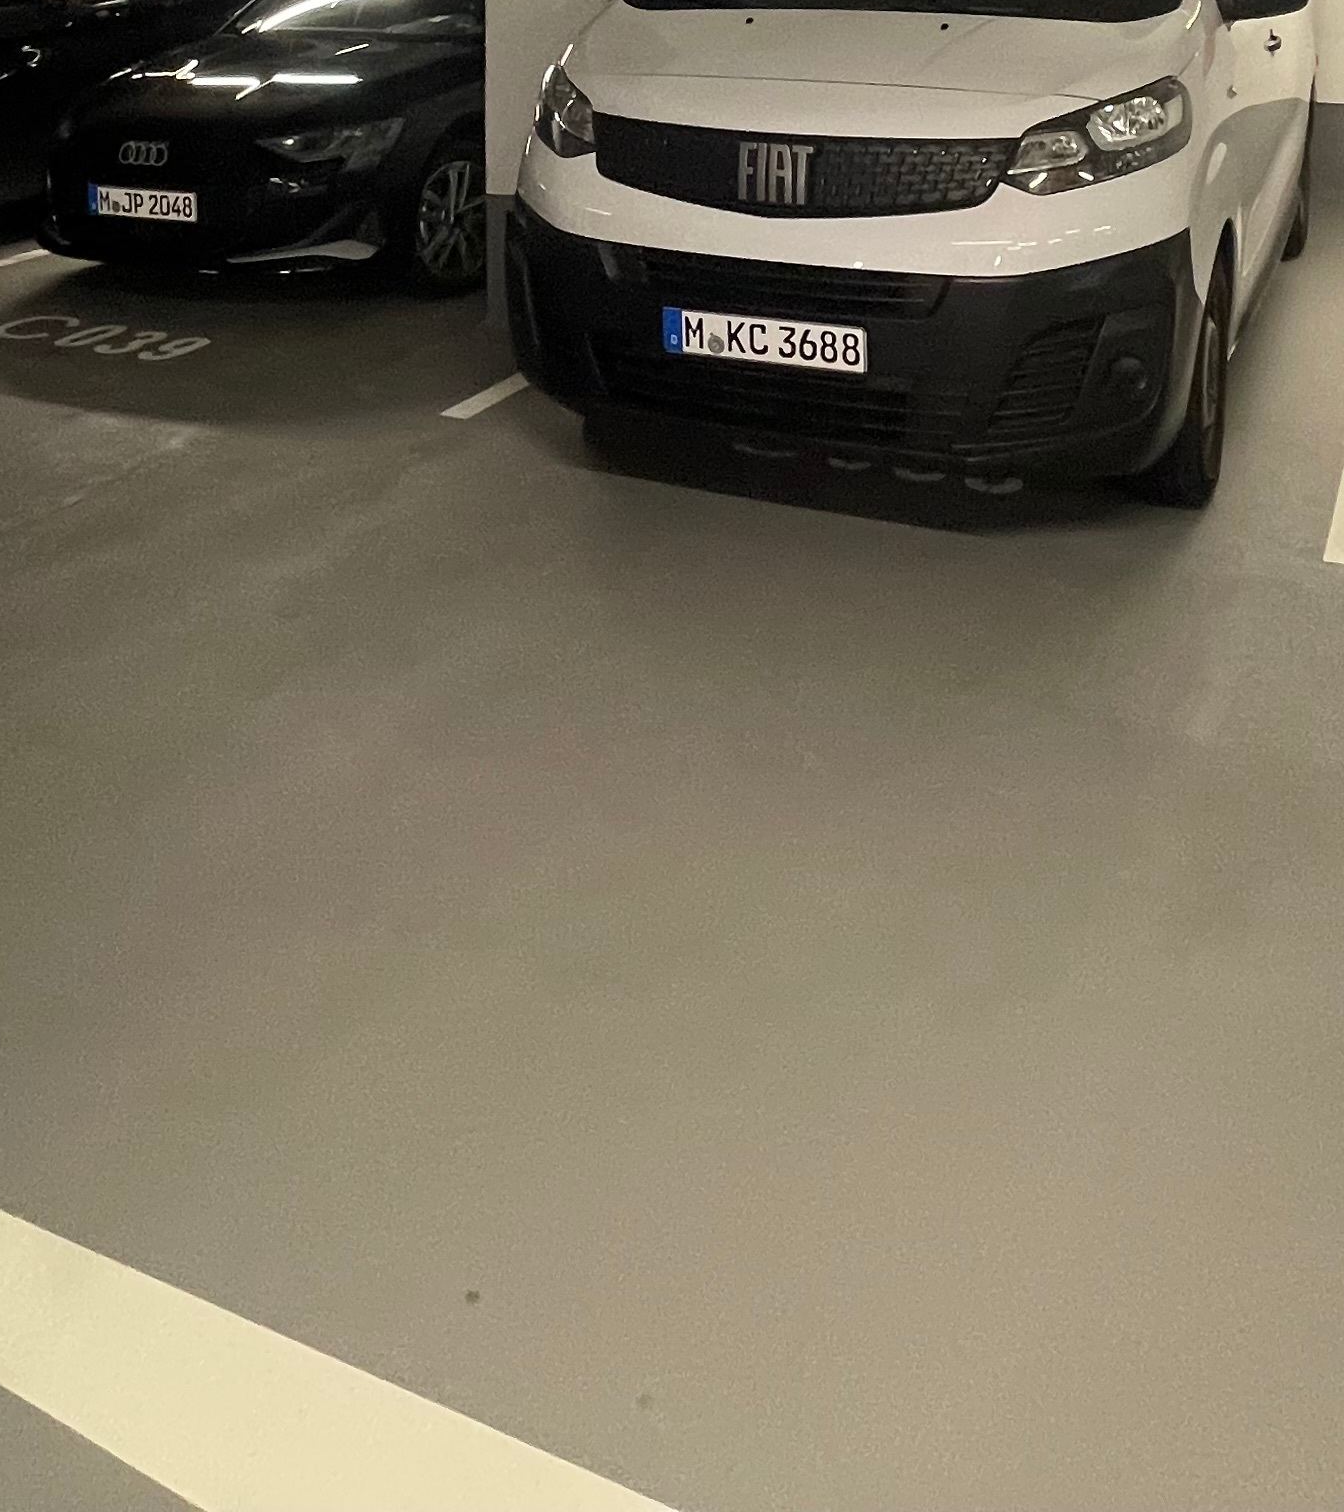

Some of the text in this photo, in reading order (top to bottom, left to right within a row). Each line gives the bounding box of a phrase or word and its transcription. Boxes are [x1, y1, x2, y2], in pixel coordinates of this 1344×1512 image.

[738, 141, 814, 206] FIAT
[122, 192, 144, 214] JP
[149, 194, 193, 219] 2048
[684, 316, 861, 366] M KC 3688
